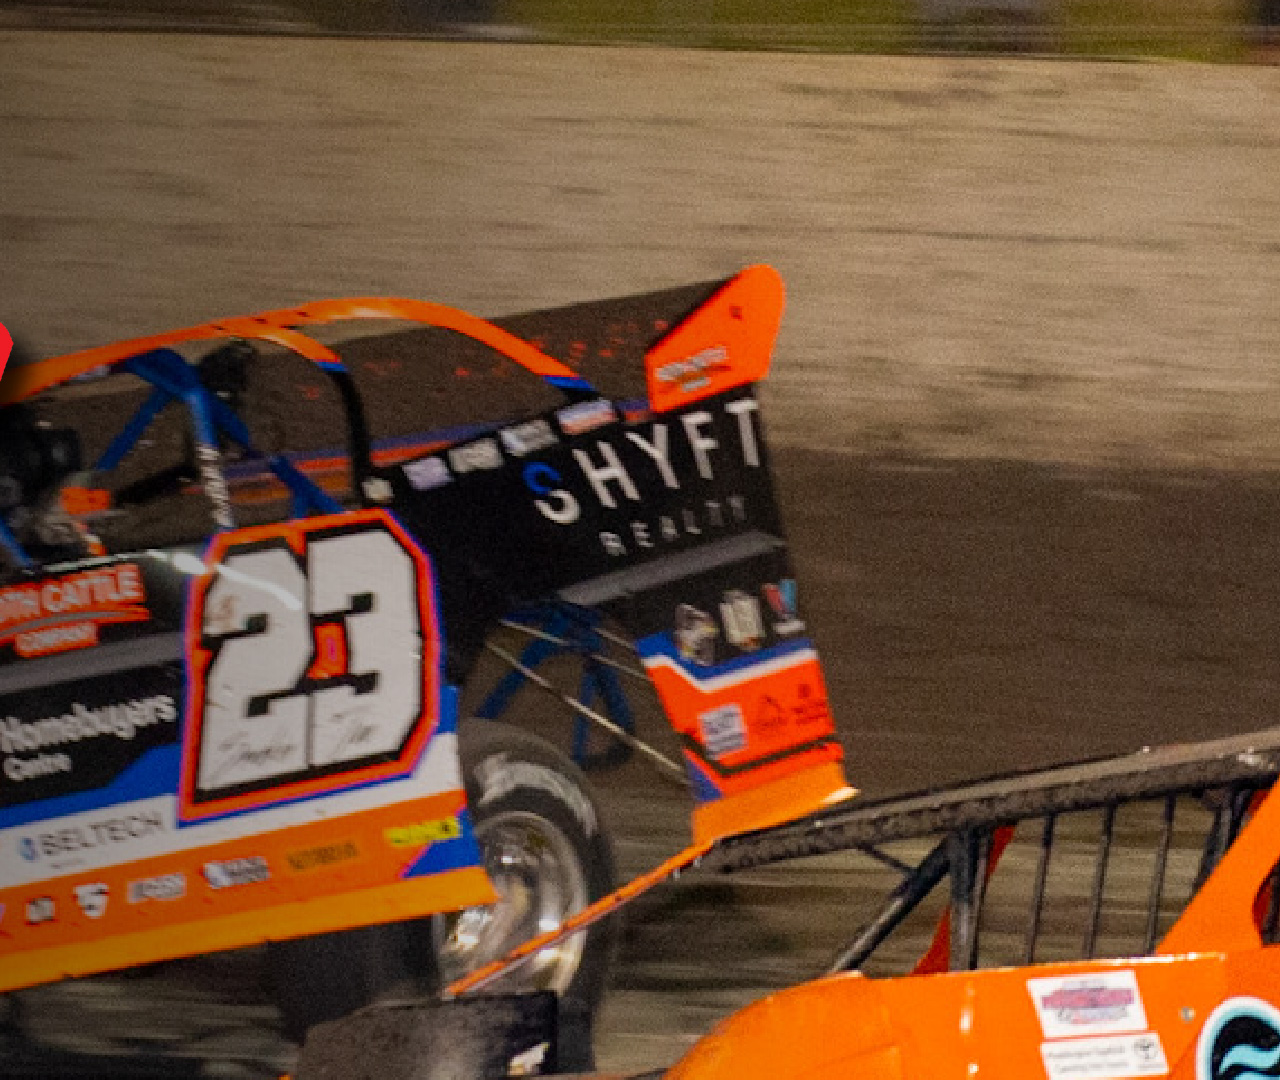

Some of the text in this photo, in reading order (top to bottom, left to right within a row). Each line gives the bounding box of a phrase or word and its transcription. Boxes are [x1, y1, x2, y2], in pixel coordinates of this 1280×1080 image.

[522, 399, 761, 525] SHYFT
[599, 496, 747, 557] REALTY
[41, 570, 144, 612] CATTLE
[191, 522, 424, 800] 23
[38, 809, 165, 857] BELTECH
